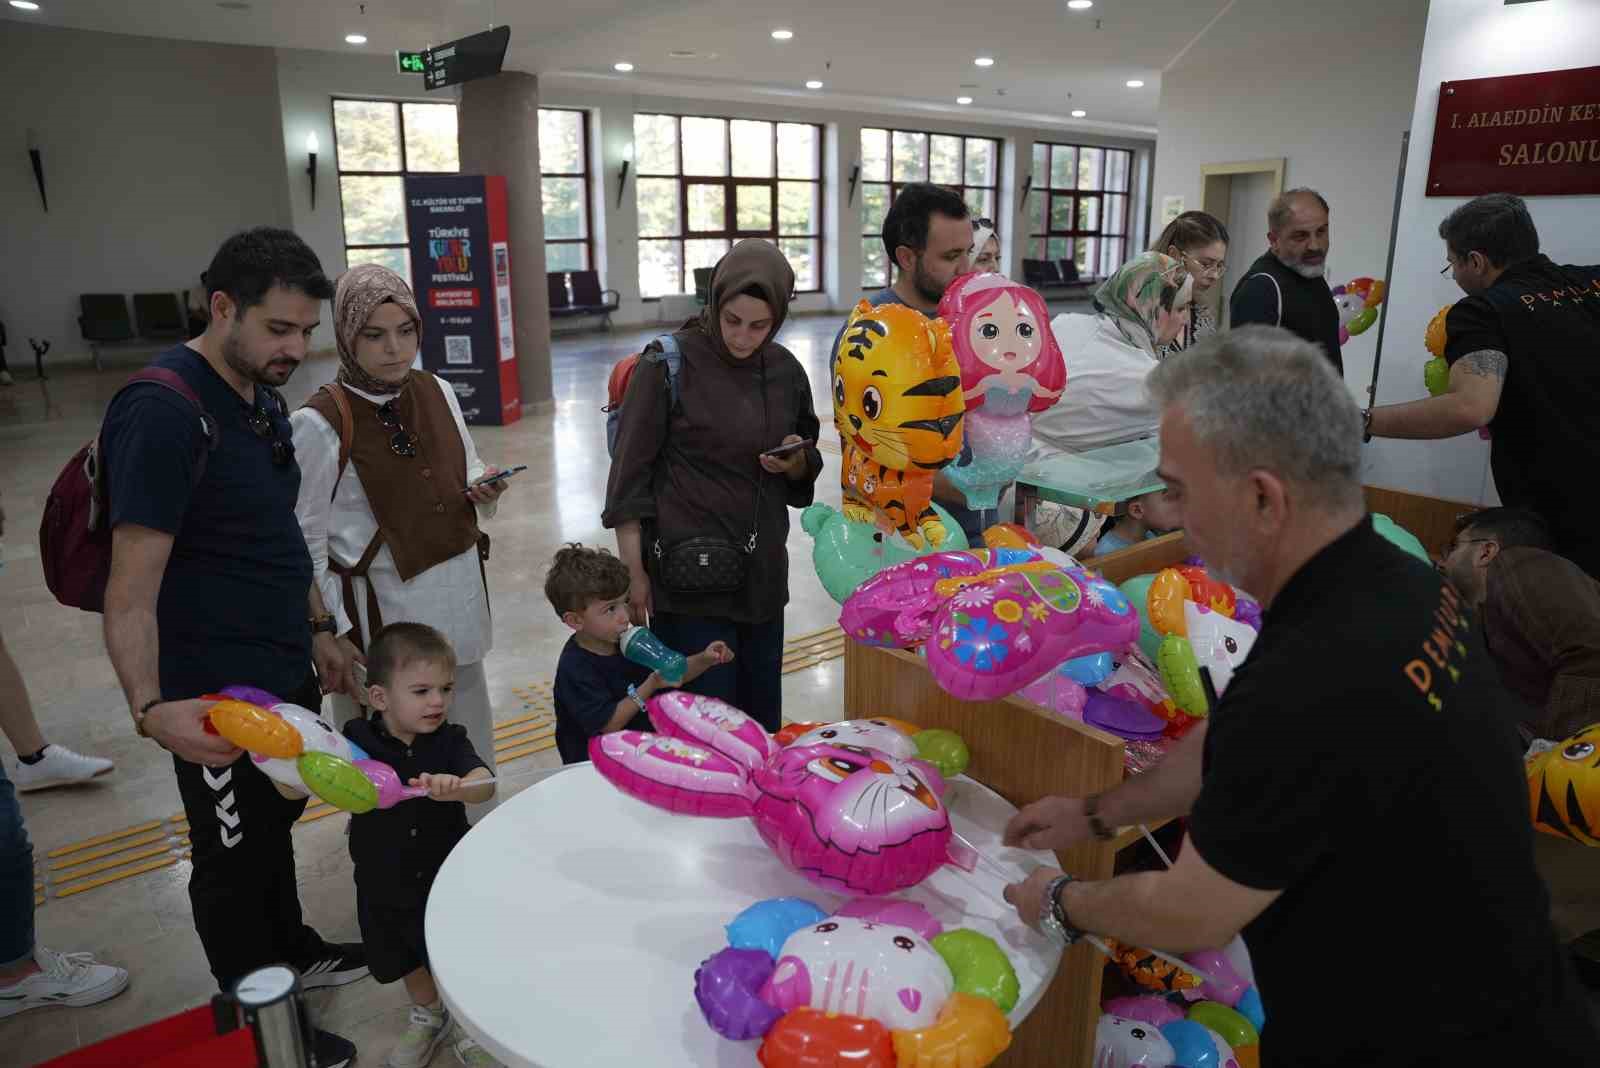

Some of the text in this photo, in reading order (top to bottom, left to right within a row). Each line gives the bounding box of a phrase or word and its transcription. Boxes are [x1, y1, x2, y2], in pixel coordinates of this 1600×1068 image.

[1467, 103, 1564, 128] ALAEDDİN
[429, 227, 470, 238] TÜRKİYE
[432, 272, 473, 282] FESTİVALİ
